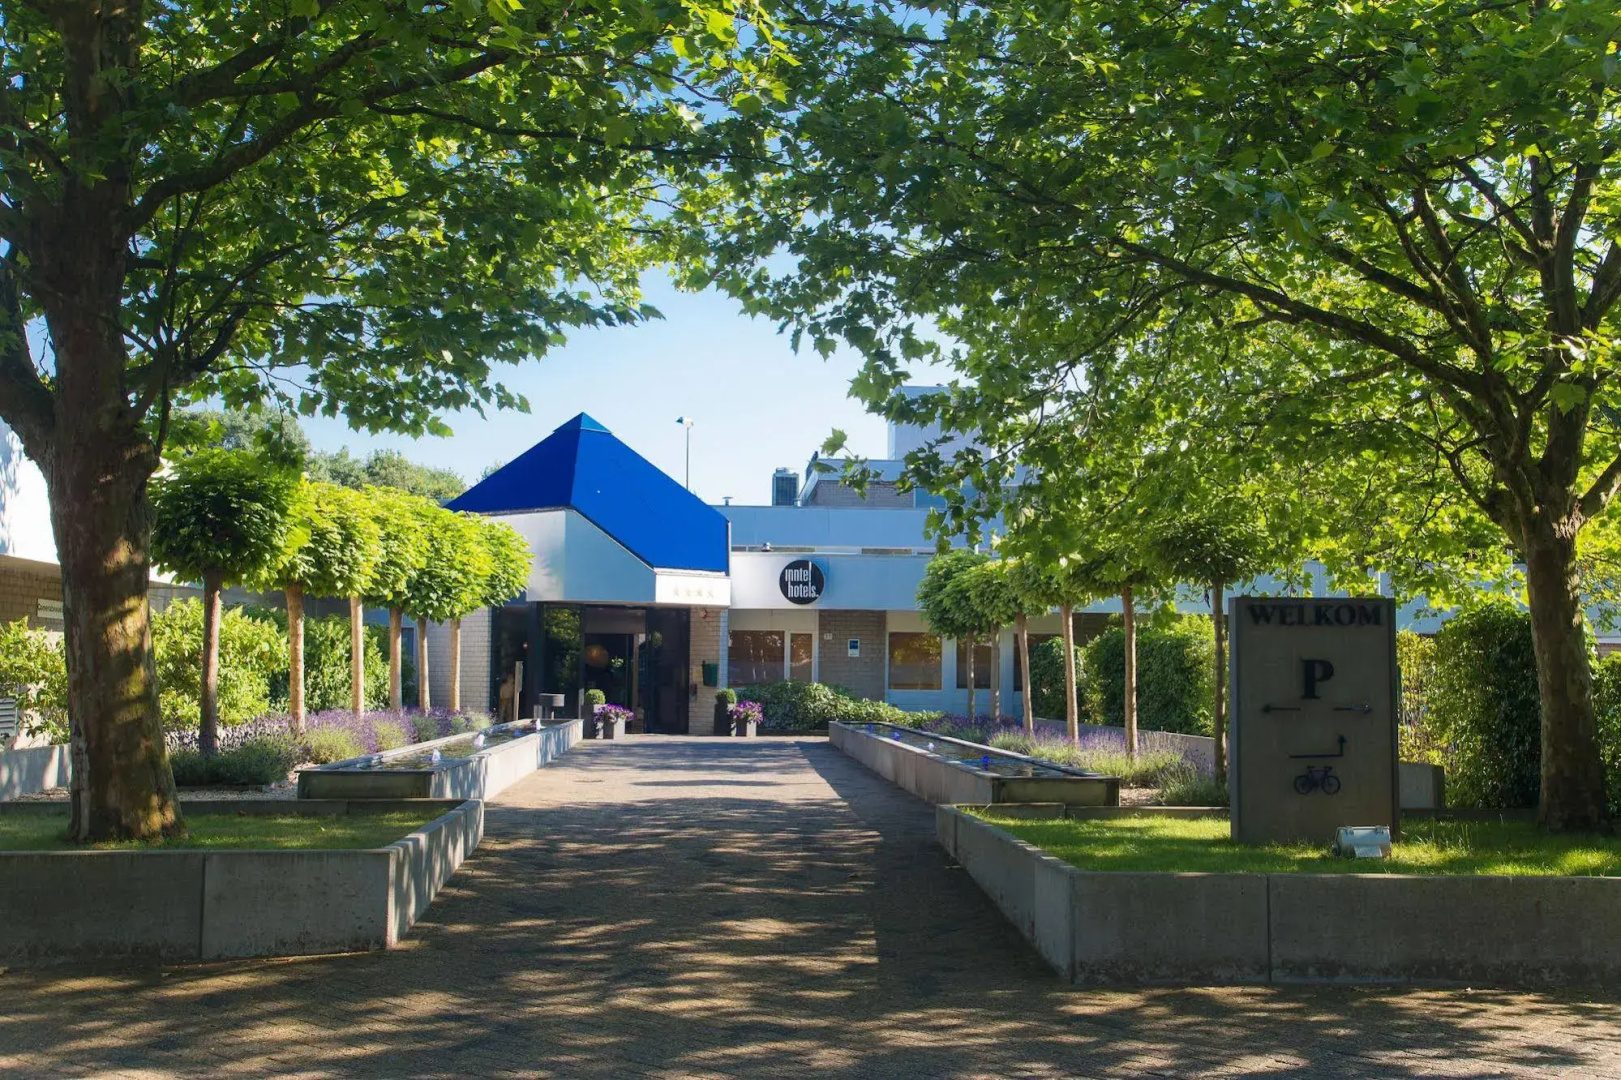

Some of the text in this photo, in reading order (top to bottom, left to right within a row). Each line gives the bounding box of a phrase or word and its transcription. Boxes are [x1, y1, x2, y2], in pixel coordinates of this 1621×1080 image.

[785, 561, 812, 582] inntel
[1247, 603, 1382, 626] WELKOM
[1301, 659, 1334, 700] P
